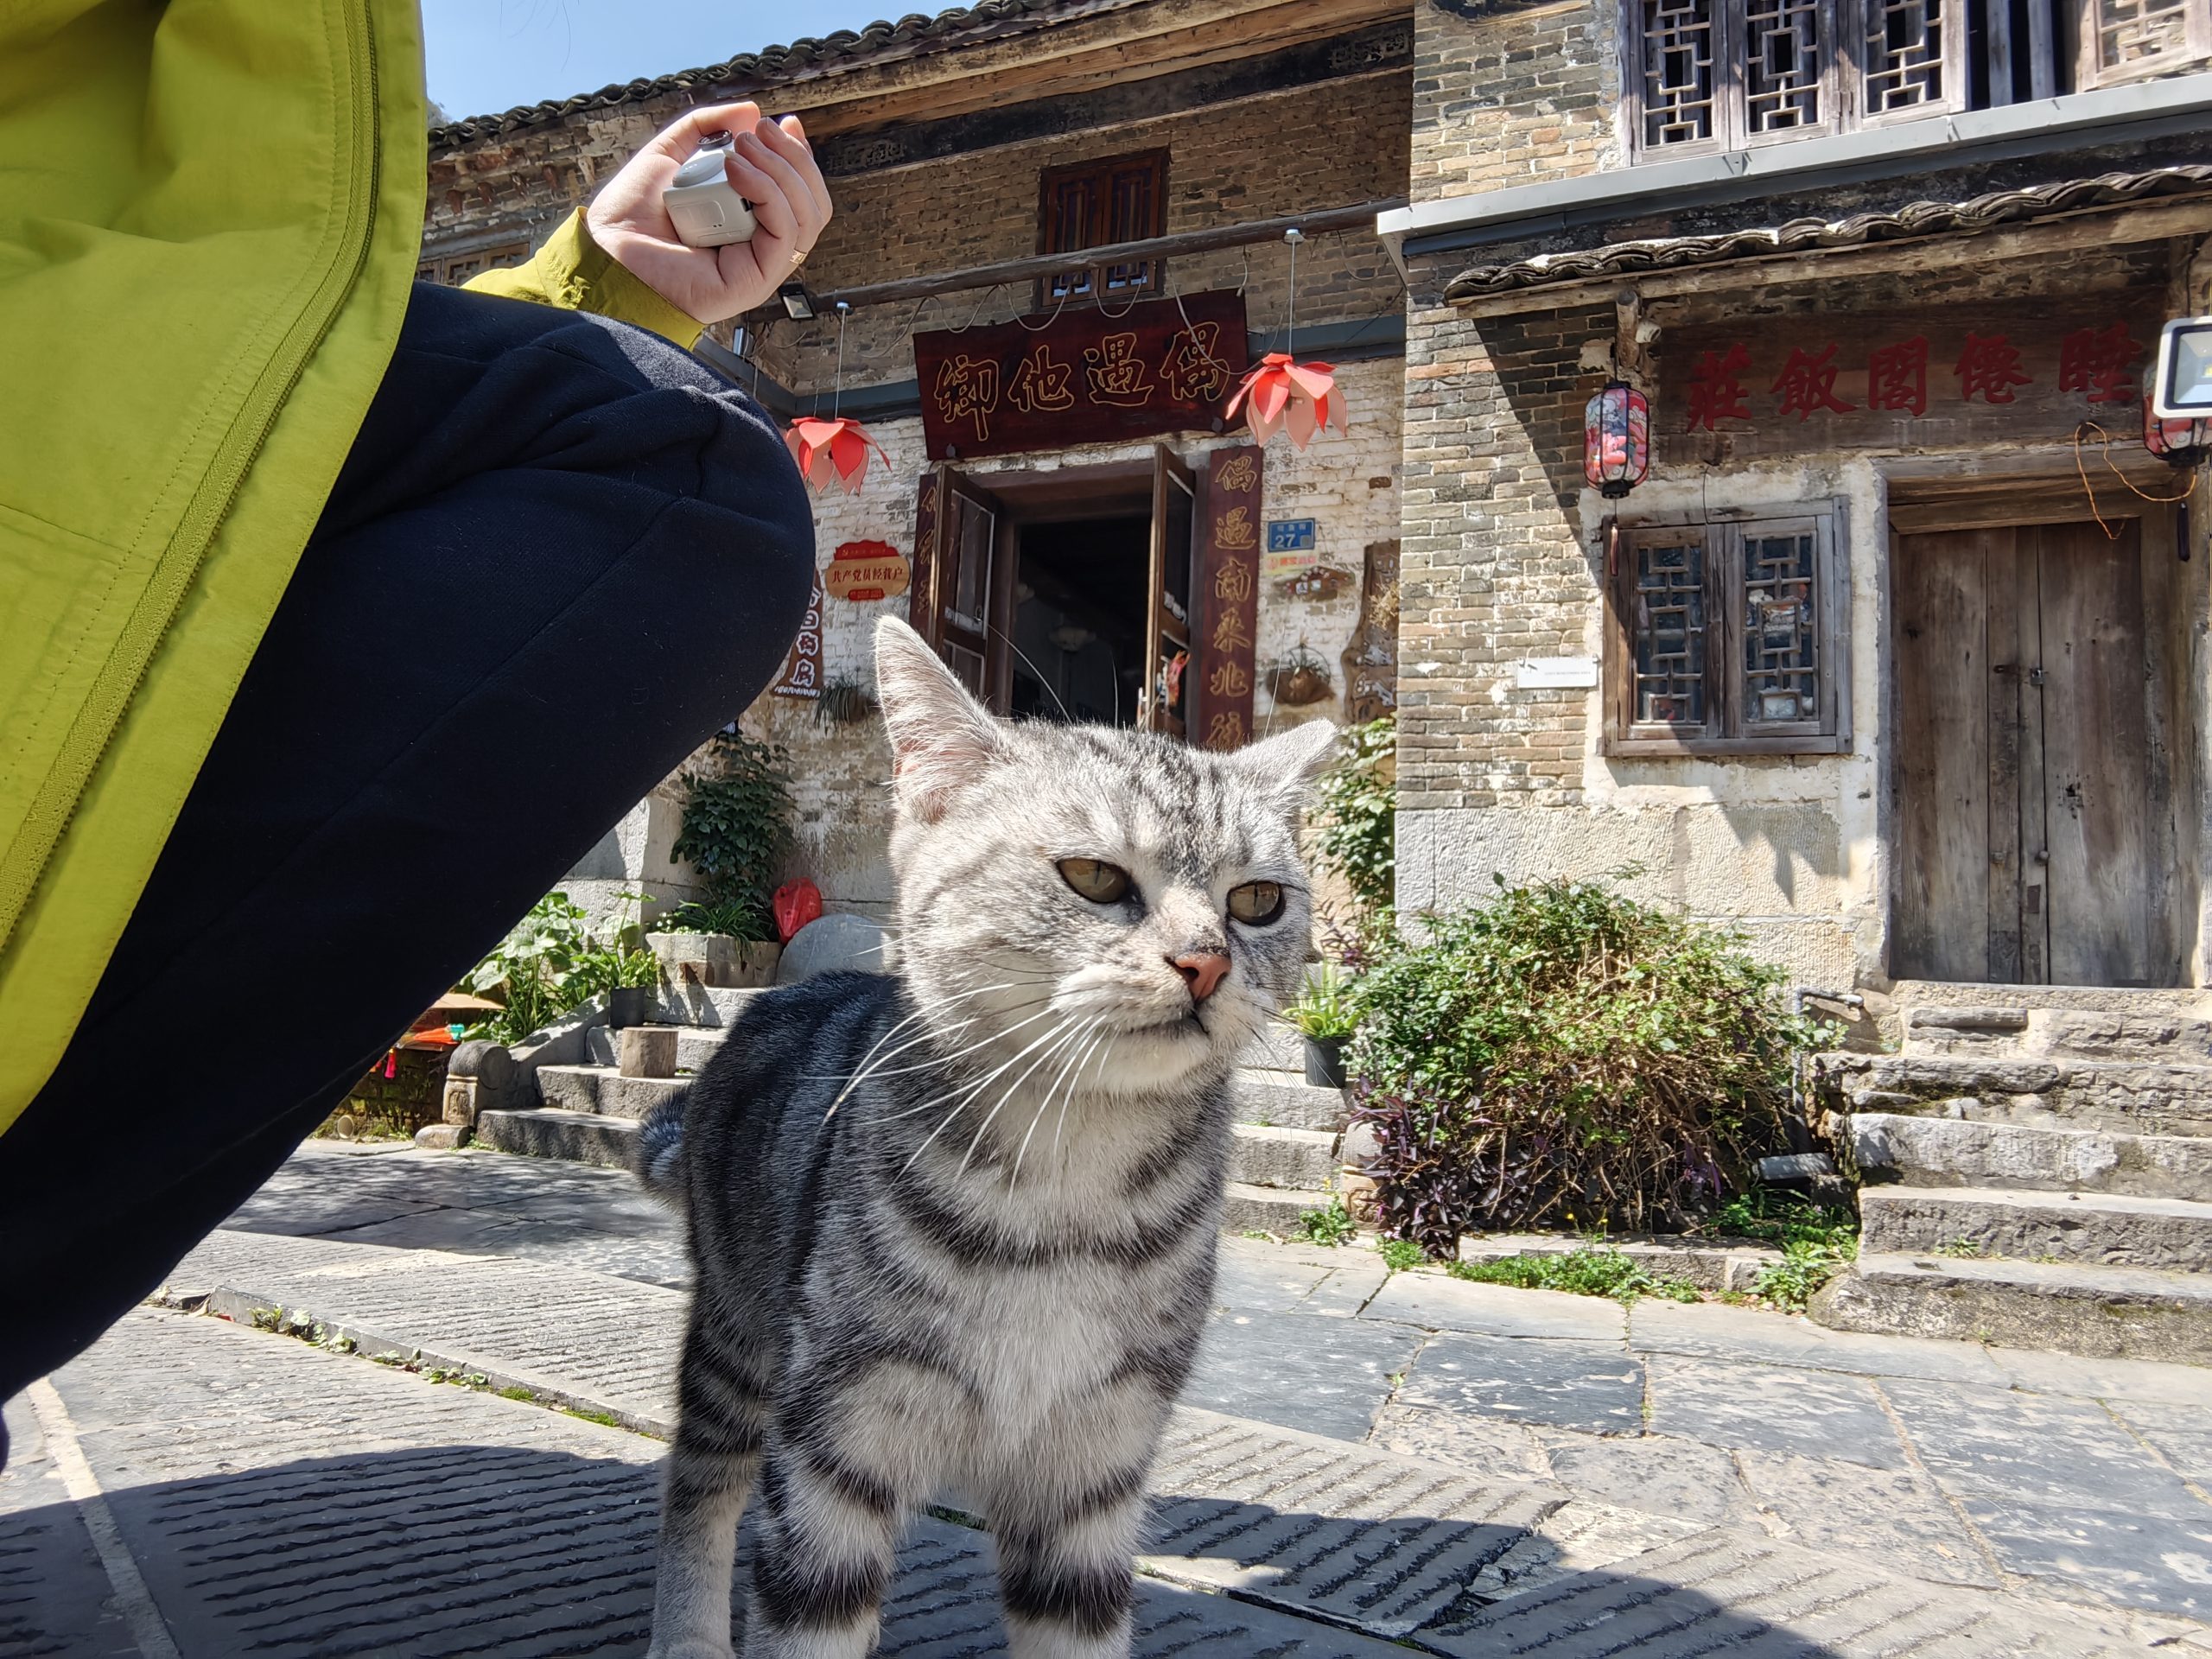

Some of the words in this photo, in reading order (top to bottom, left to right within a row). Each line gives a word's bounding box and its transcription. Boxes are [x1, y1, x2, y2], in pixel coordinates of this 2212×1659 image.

[1274, 533, 1296, 549] 27
[832, 566, 904, 583] 共产党员经营户
